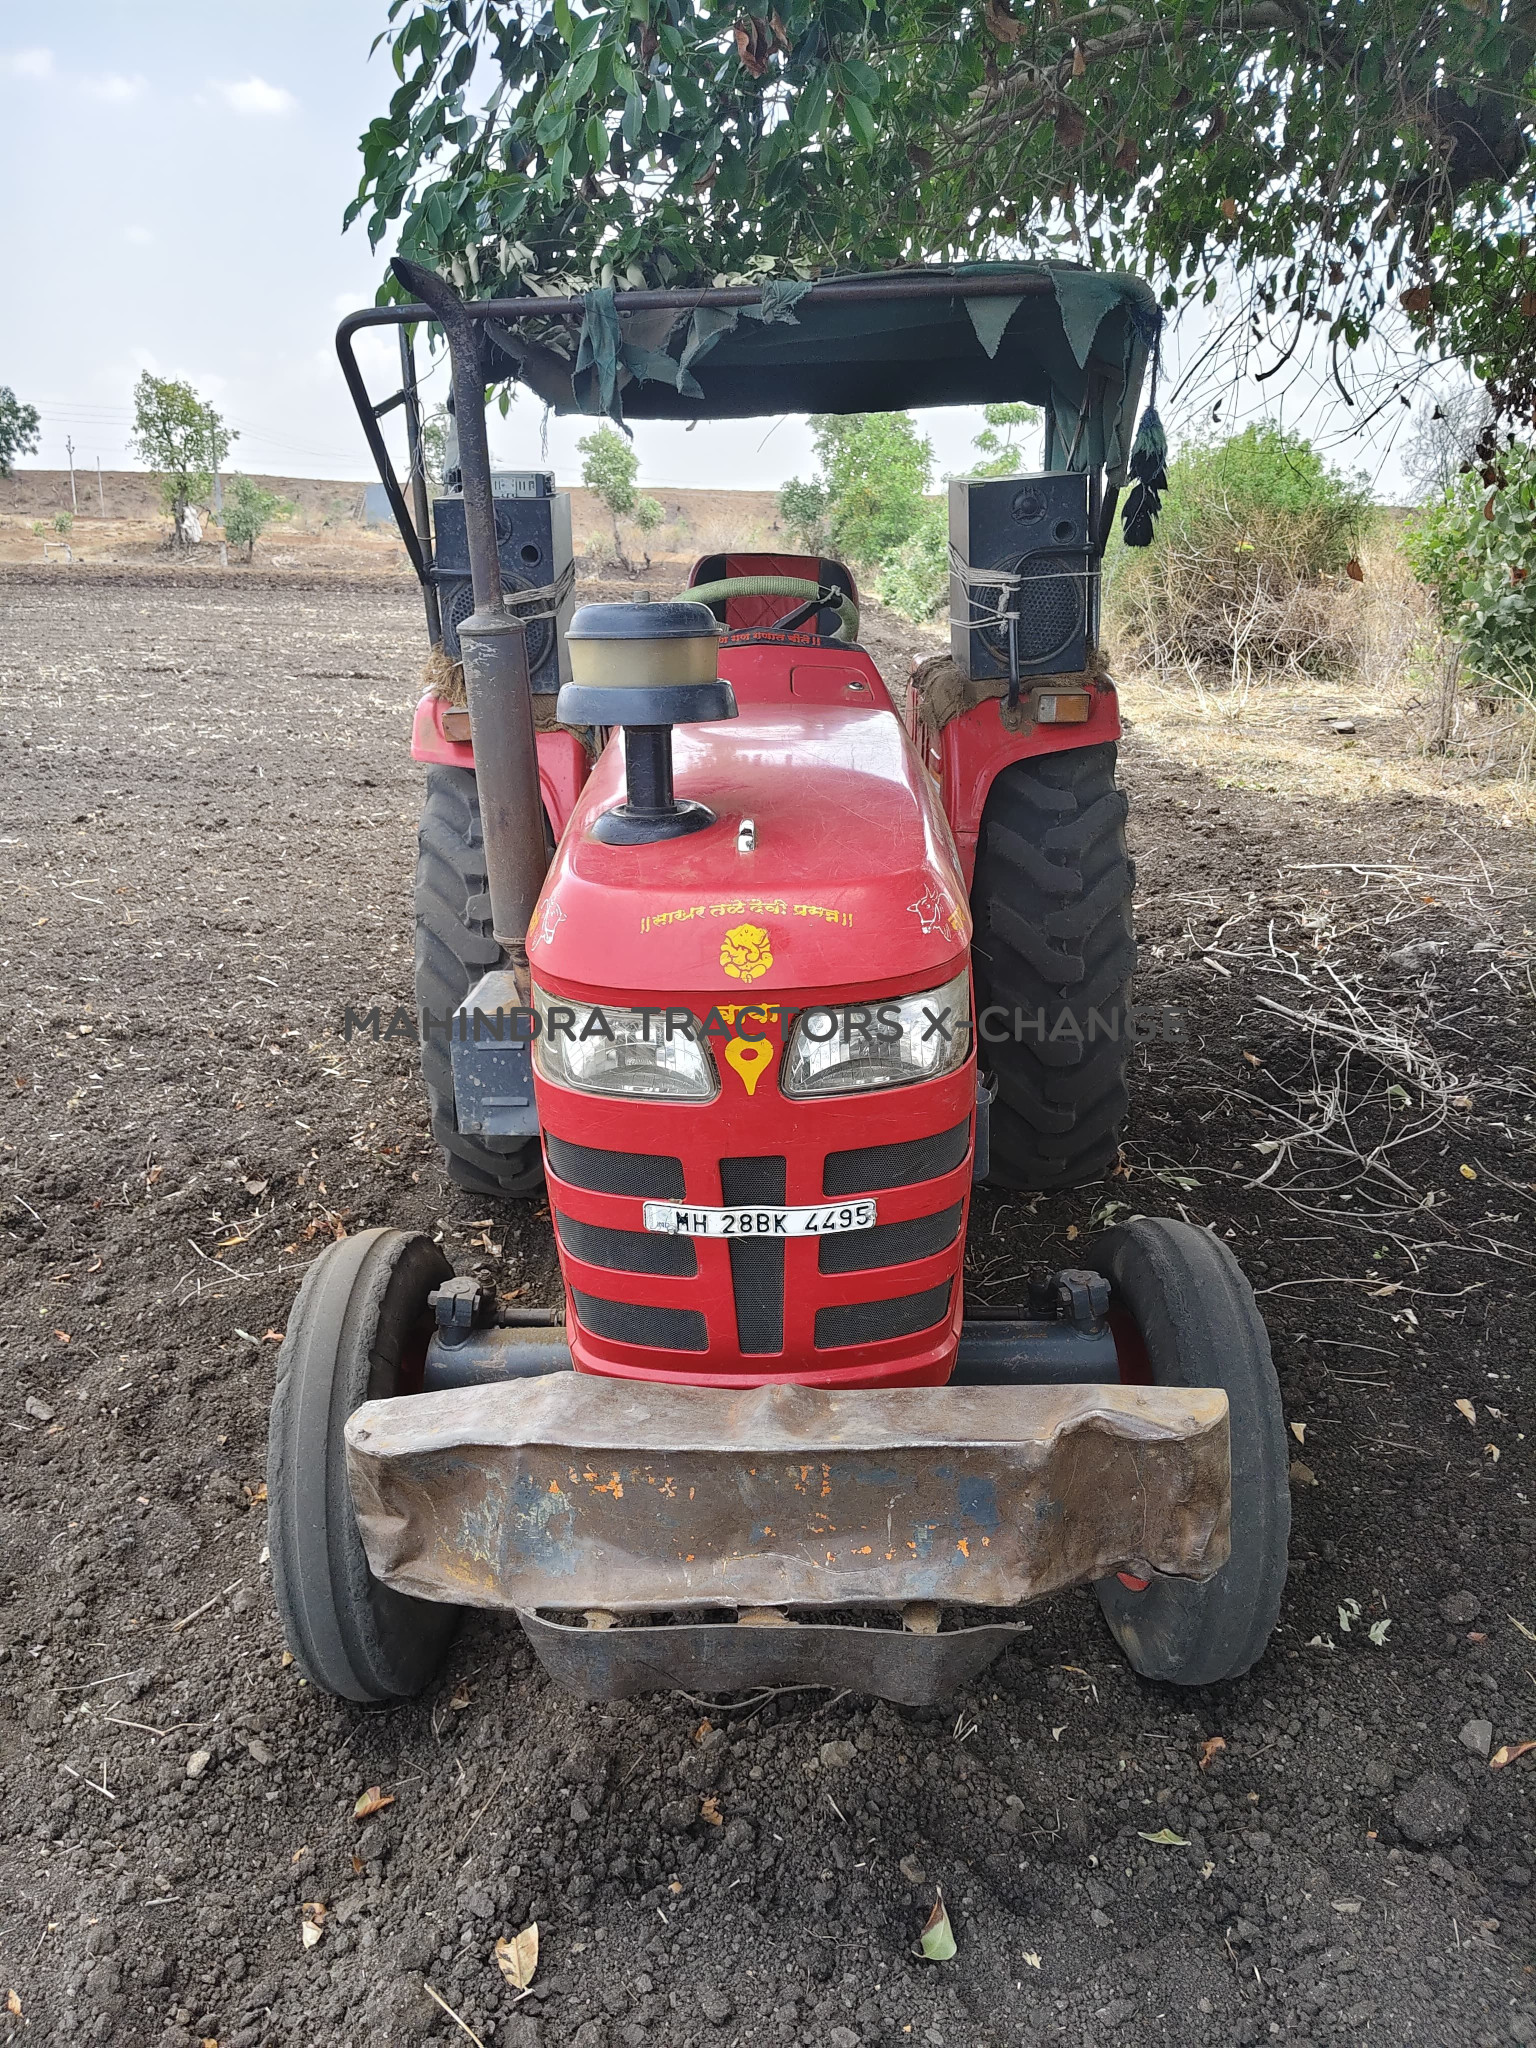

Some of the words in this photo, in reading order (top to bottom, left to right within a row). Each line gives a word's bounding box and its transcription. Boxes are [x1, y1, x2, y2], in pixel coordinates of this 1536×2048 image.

[676, 1211, 707, 1234] MH
[721, 1213, 788, 1234] 28BK
[804, 1205, 870, 1232] 4495
